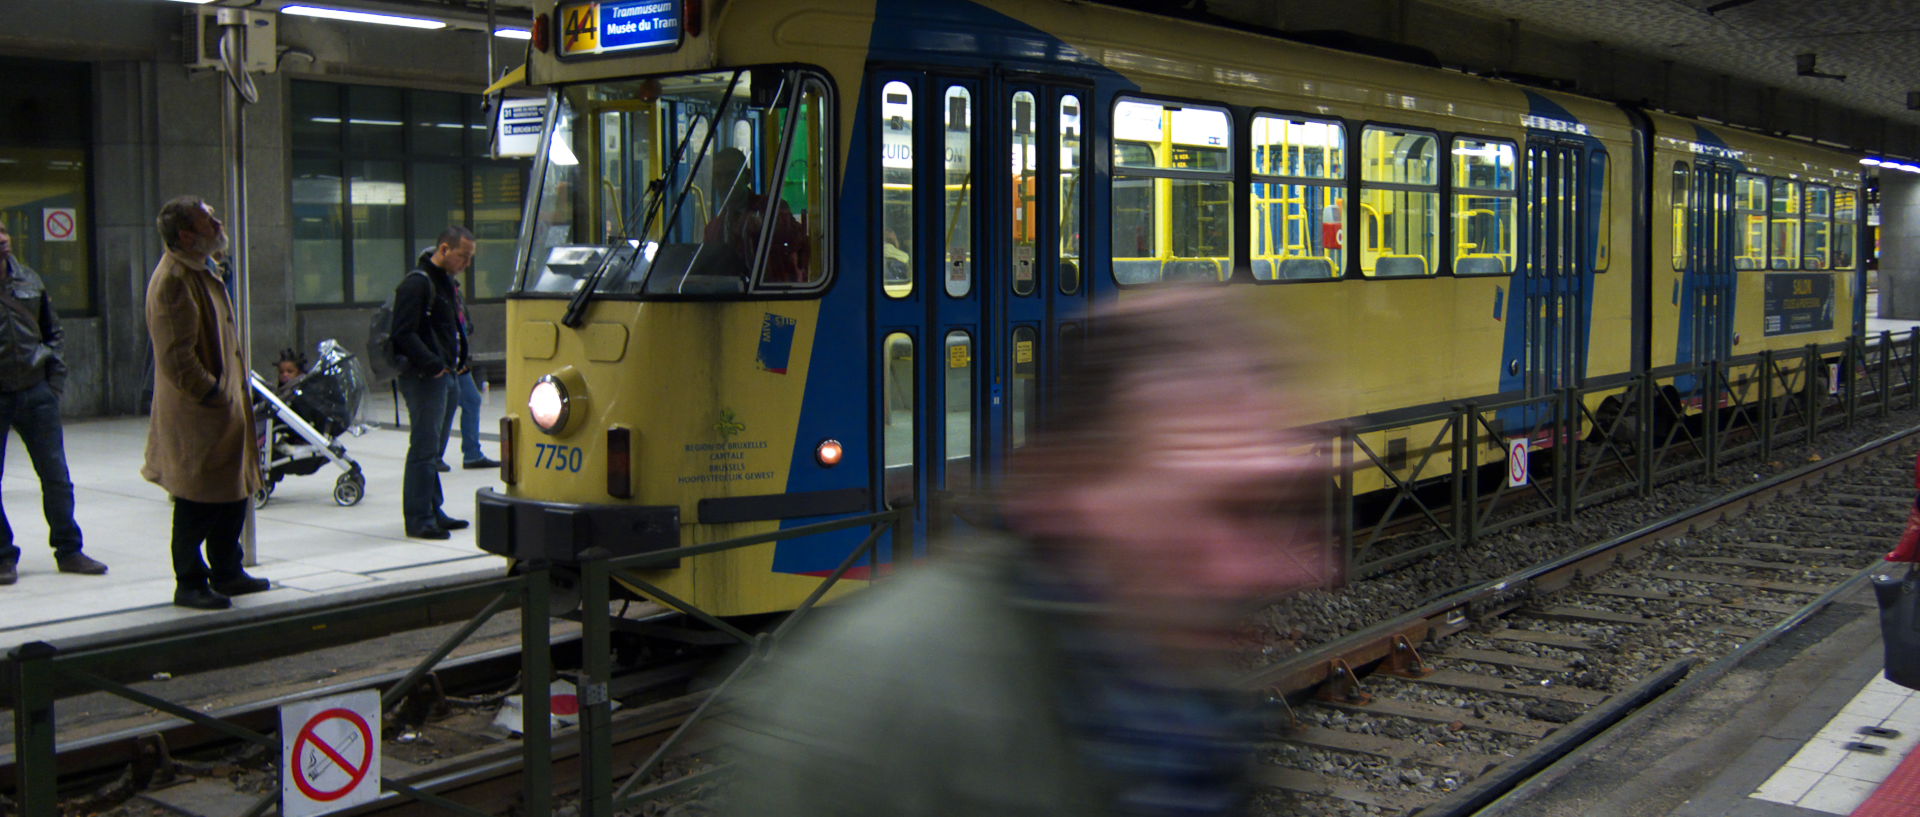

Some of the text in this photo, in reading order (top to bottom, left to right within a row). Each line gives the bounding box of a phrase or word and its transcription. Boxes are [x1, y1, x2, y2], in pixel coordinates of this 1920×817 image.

[612, 3, 672, 18] Trammuseum
[565, 6, 598, 42] 44
[607, 17, 678, 36] Musée du Tram
[727, 441, 768, 450] BRUXELLES
[535, 443, 583, 473] 7750
[709, 452, 744, 460] CAPITALE
[709, 463, 745, 472] BRUSSELS
[744, 471, 775, 481] GEWEST
